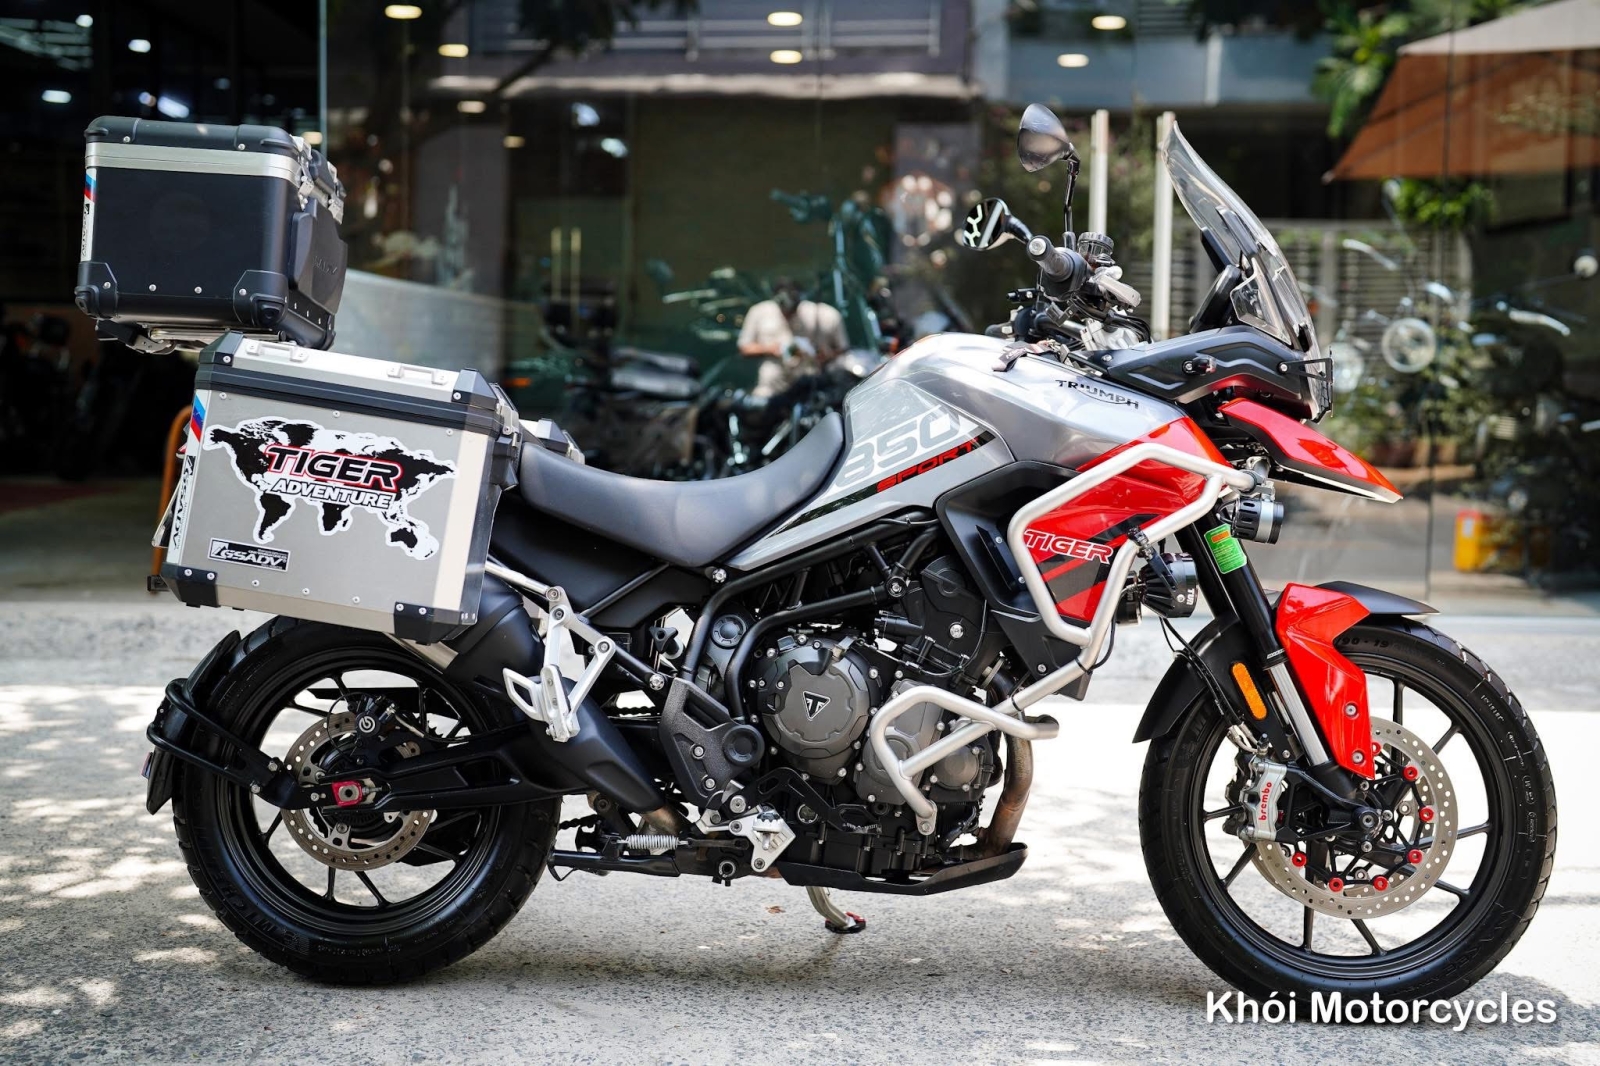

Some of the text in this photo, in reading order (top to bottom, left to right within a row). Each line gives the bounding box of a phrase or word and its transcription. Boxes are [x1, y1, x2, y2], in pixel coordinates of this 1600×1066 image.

[1055, 380, 1139, 409] TRIUMPH
[265, 445, 402, 491] TIGER
[835, 411, 960, 488] 850
[876, 437, 979, 493] SPORT
[270, 478, 393, 509] ADVENTURE
[1024, 529, 1113, 565] TIGER
[1259, 782, 1272, 821] brembo
